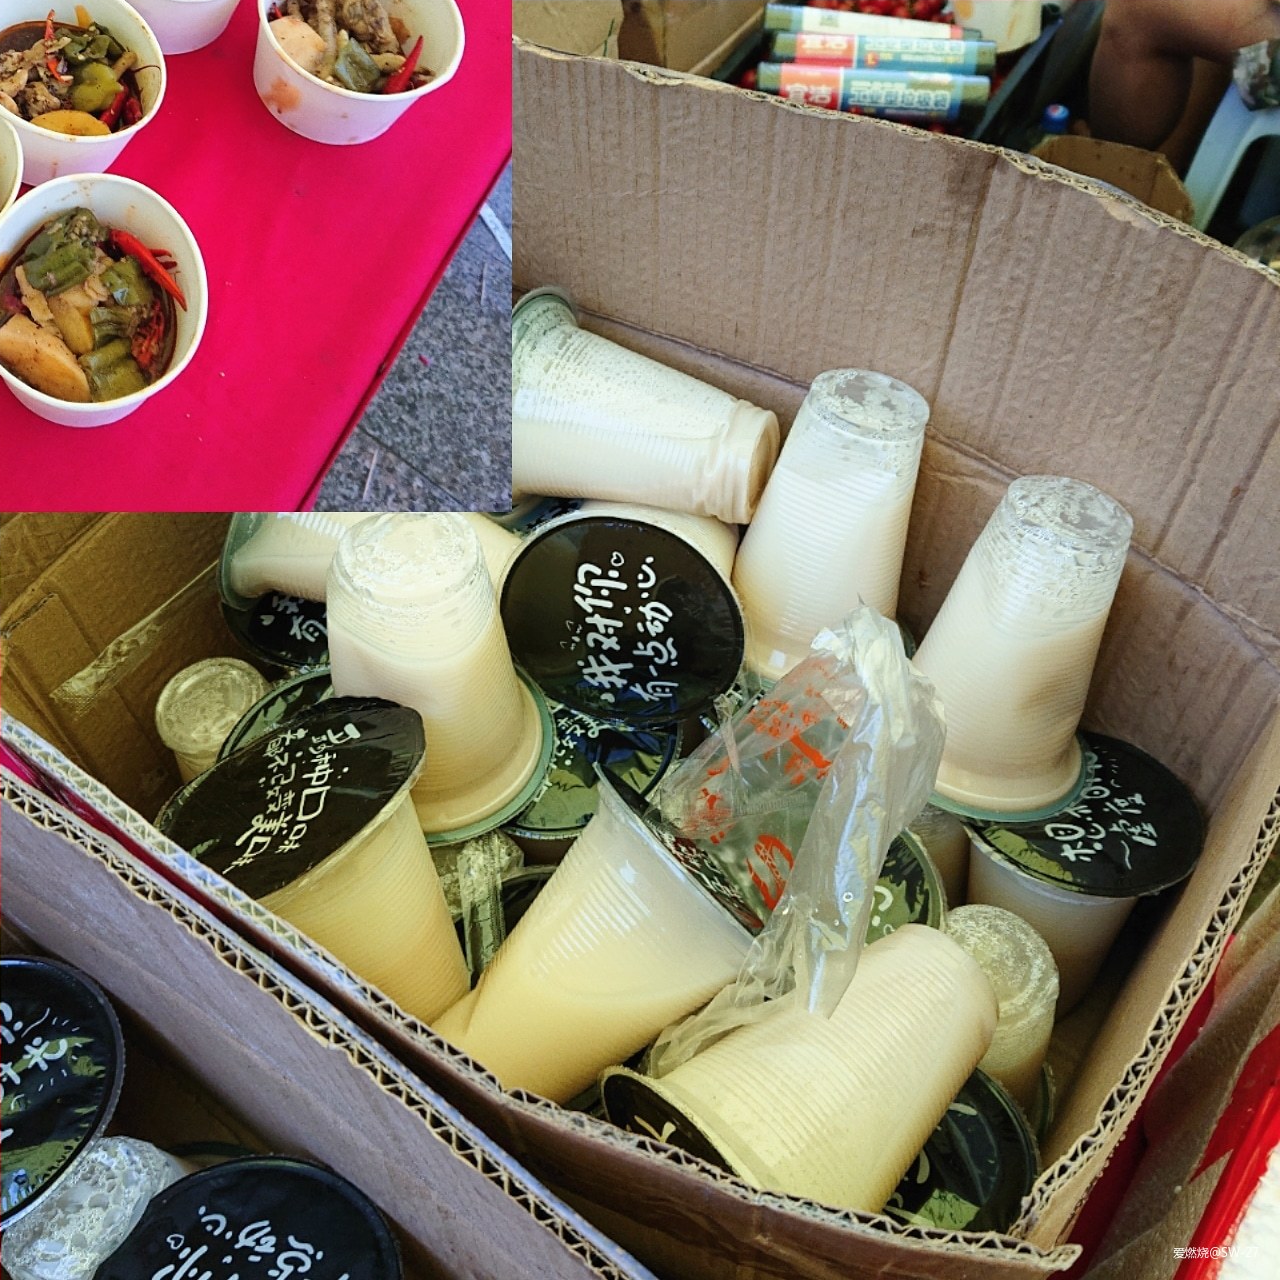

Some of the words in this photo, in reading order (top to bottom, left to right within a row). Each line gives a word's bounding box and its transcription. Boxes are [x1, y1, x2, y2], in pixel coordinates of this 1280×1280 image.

[573, 562, 634, 689] 我对你
[630, 556, 680, 702] 有一点动心
